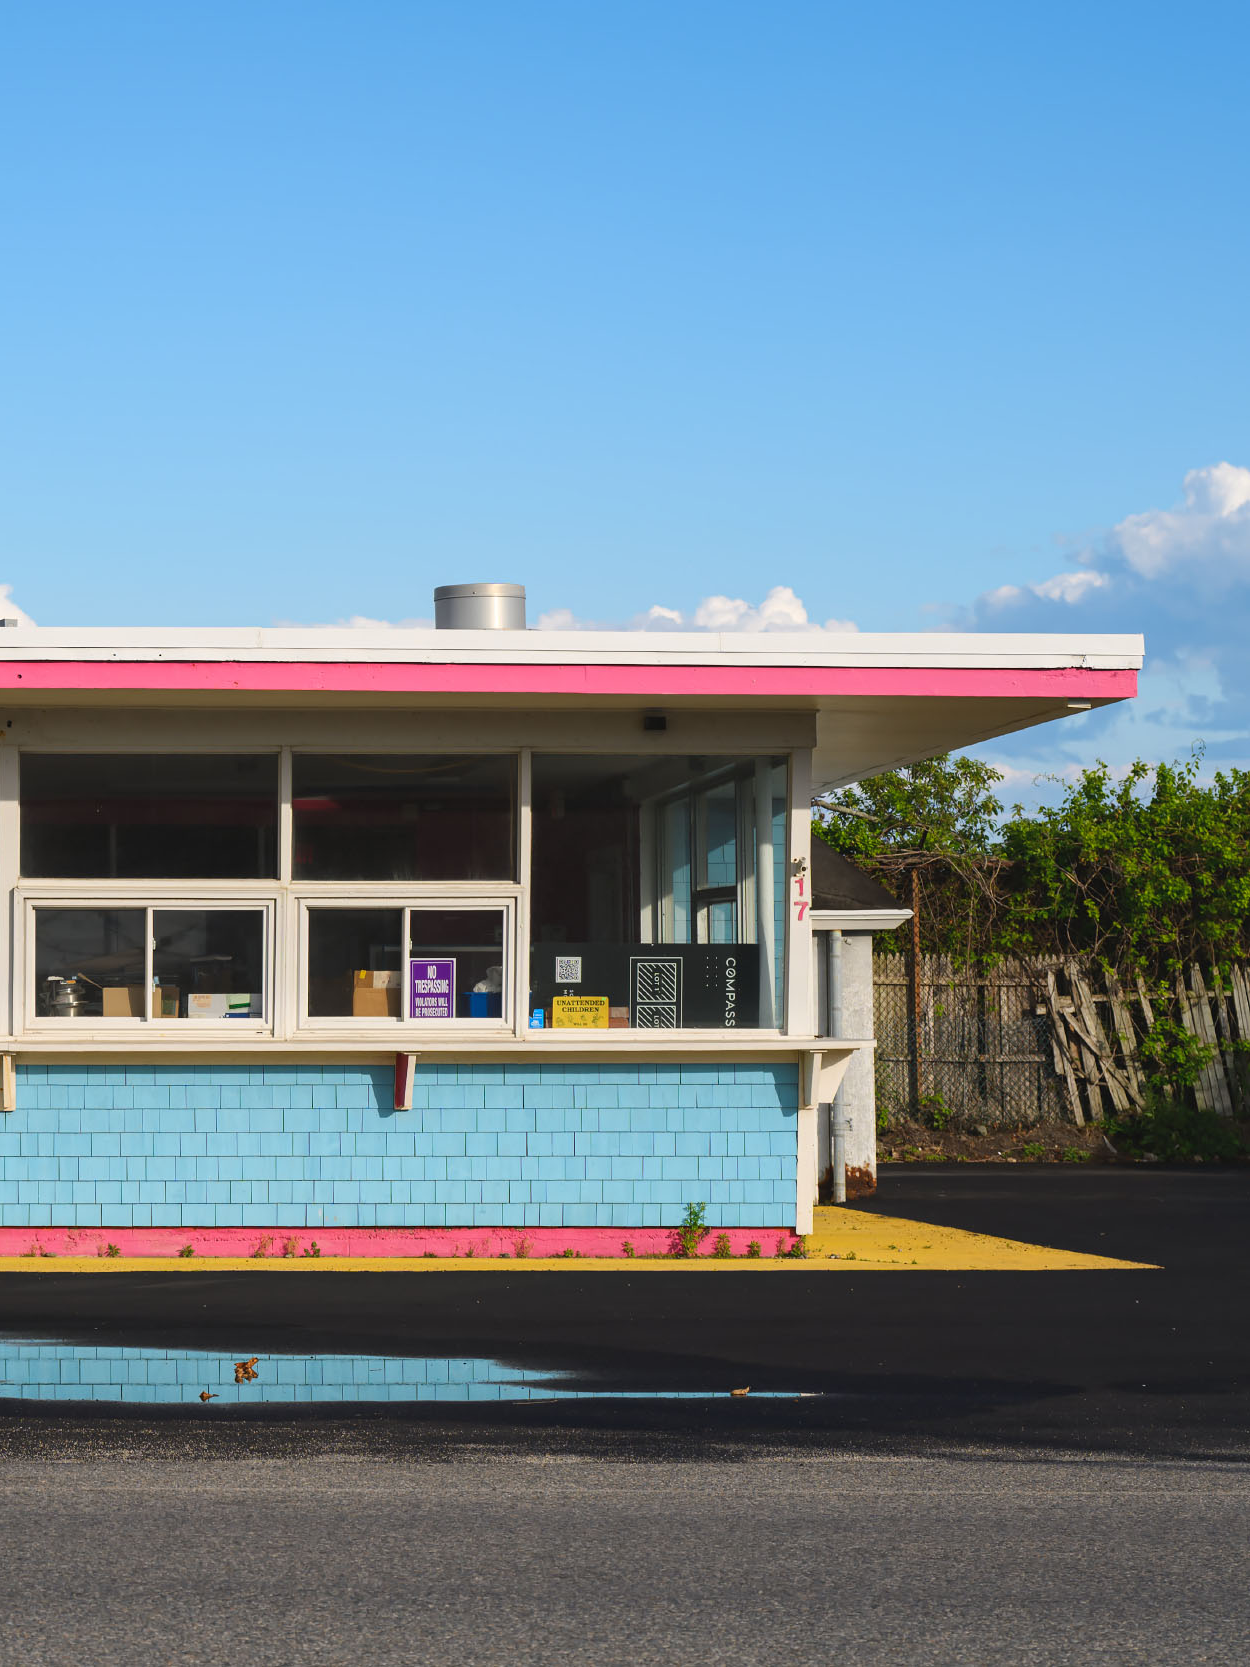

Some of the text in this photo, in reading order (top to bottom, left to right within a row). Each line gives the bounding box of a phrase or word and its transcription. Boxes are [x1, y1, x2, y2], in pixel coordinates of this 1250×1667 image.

[794, 878, 809, 921] 17
[427, 965, 437, 979] NO
[415, 979, 449, 994] TRESPASSING
[725, 957, 737, 1027] COMPASS
[415, 997, 448, 1007] VIOLATORS WILL
[415, 1008, 448, 1017] BE PROSECUTED
